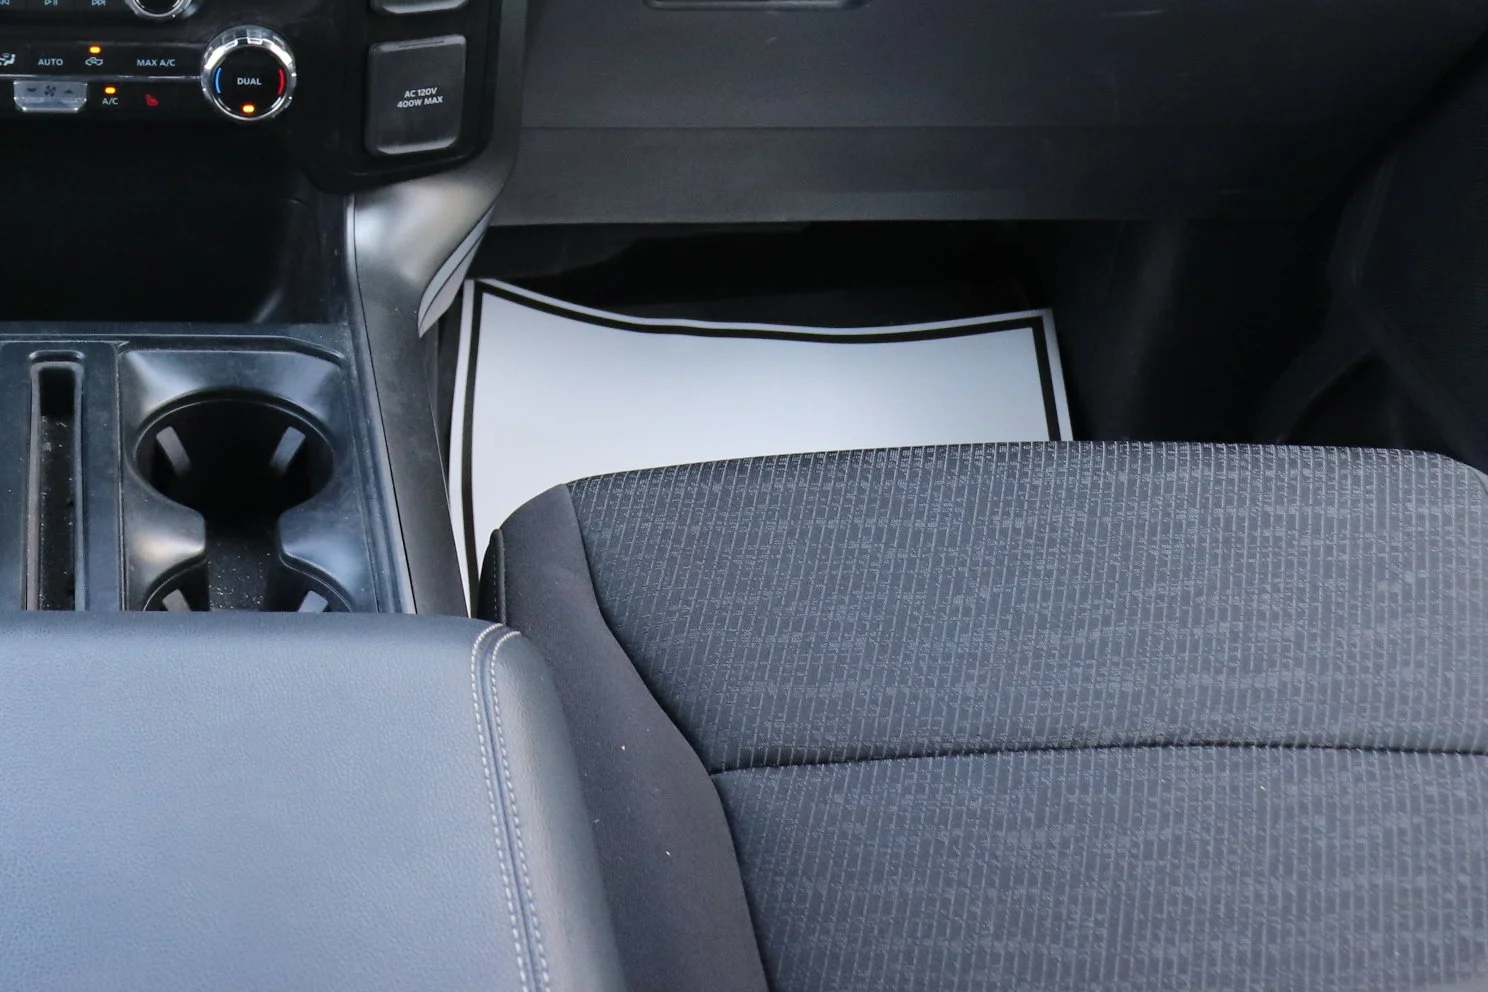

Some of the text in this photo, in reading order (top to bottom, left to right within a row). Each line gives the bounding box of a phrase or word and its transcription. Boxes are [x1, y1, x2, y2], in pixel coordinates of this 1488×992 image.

[38, 58, 64, 66] AUTO
[136, 58, 176, 67] MAX A/C
[237, 77, 262, 85] DUAL
[404, 87, 438, 98] AC 120V
[102, 97, 119, 105] A/C
[396, 96, 444, 108] 400W MAX
